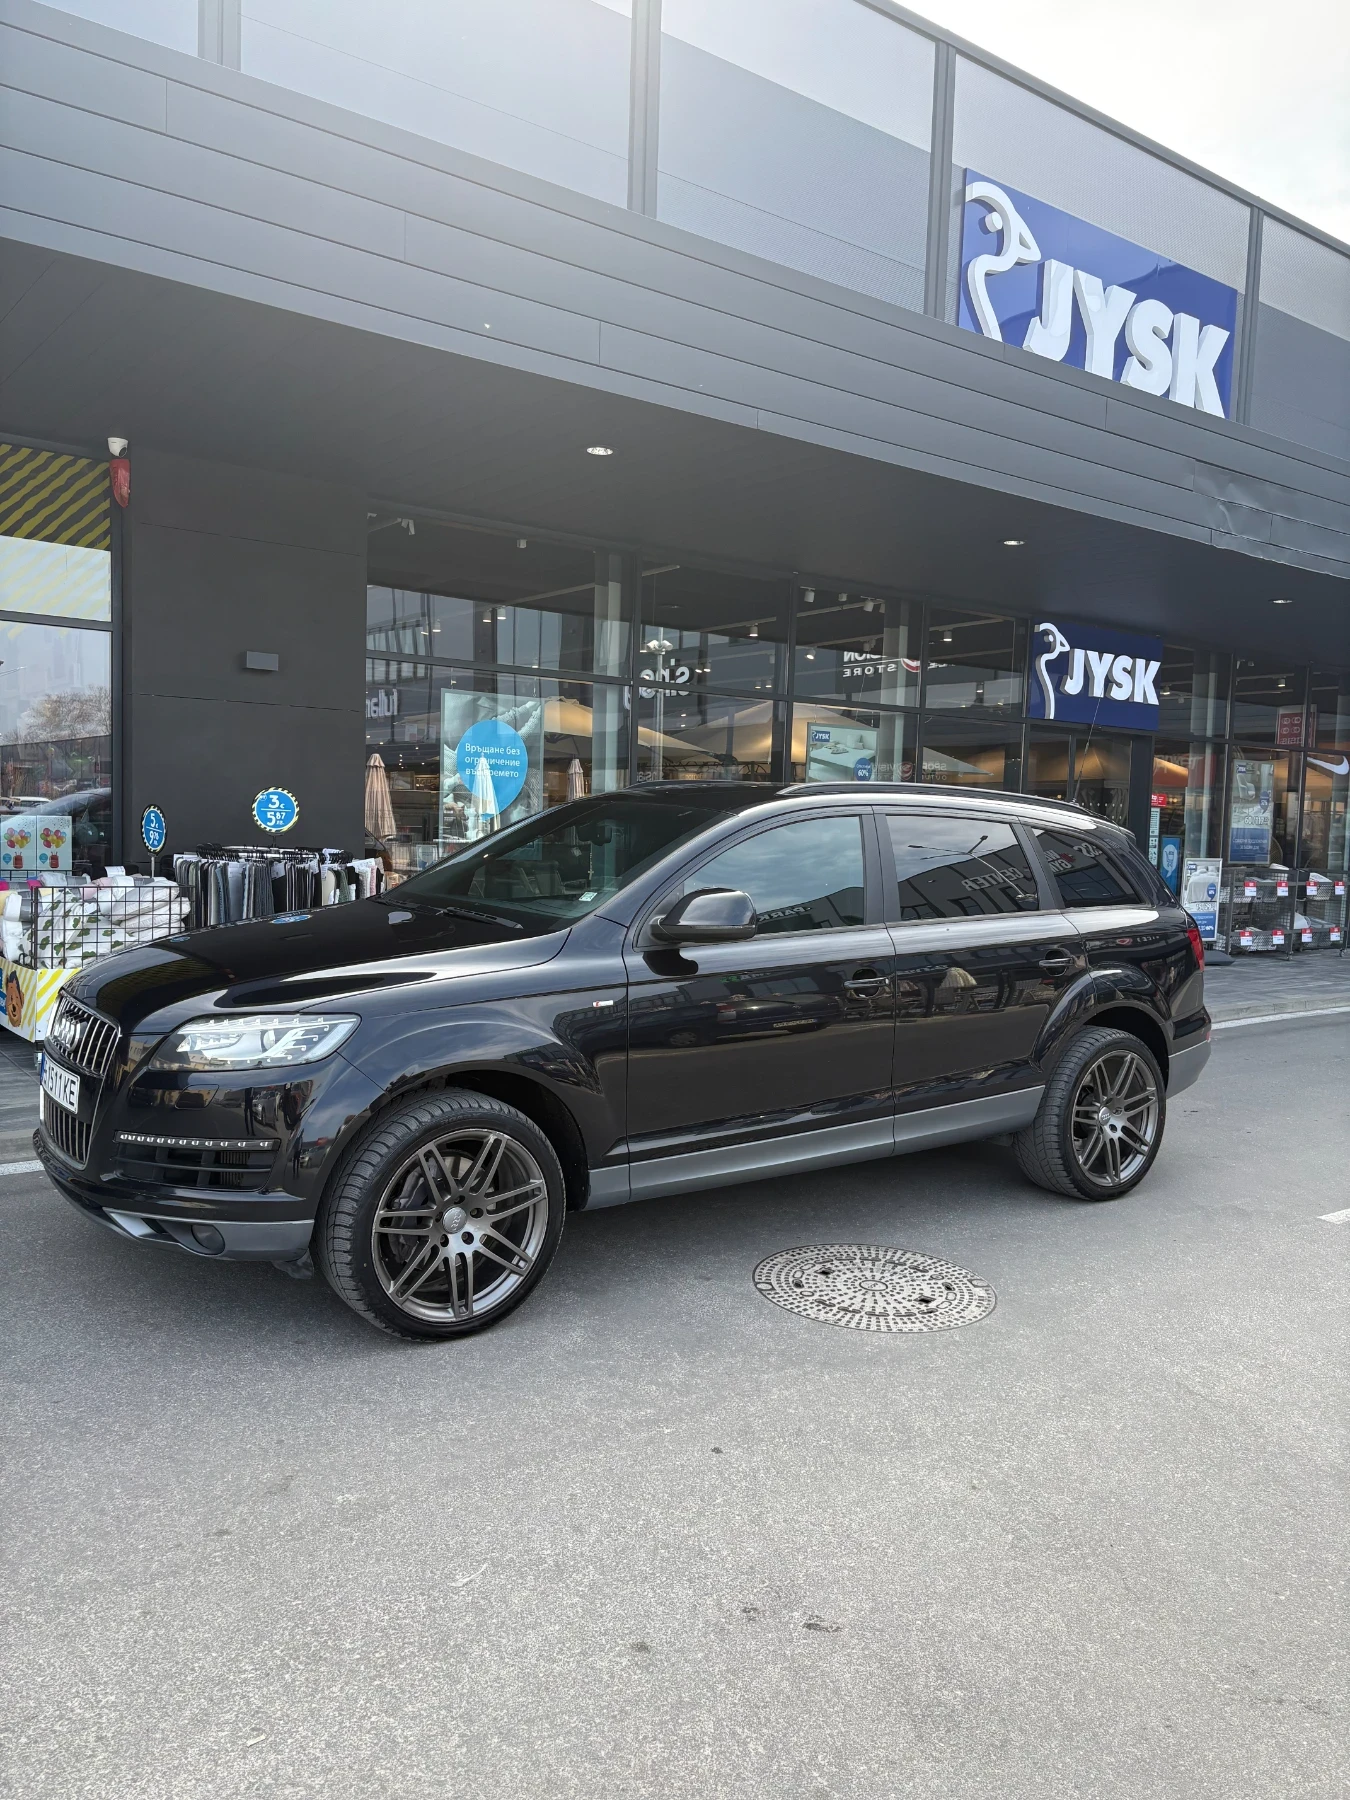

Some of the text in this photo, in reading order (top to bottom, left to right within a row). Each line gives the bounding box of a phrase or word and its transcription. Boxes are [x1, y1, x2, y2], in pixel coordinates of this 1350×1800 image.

[1022, 258, 1230, 419] JYSK
[1060, 648, 1161, 706] JYSK
[465, 743, 521, 756] Връщане без
